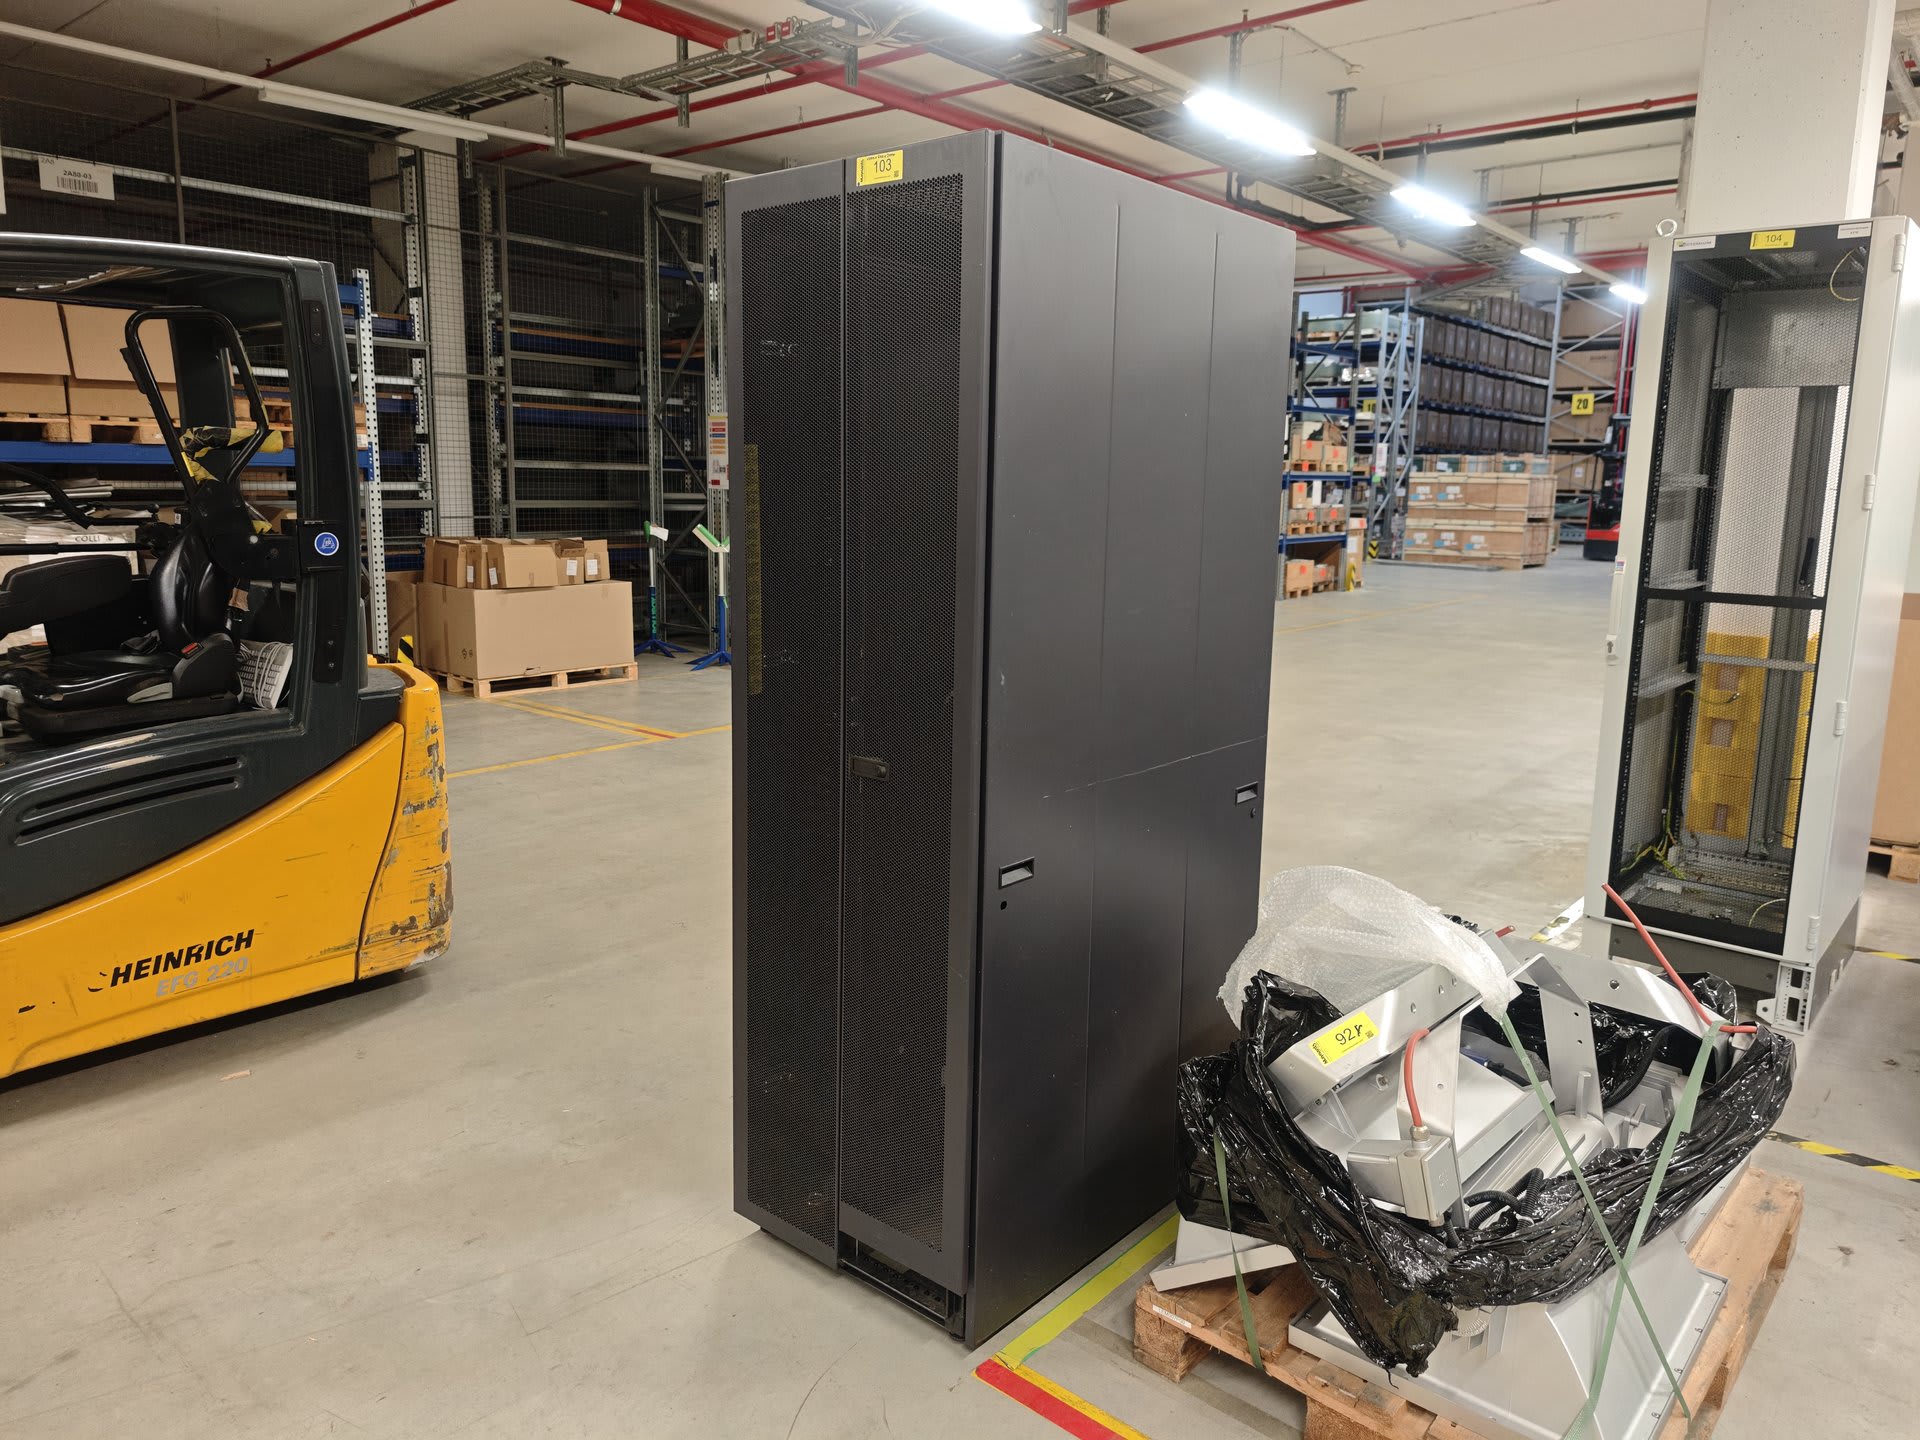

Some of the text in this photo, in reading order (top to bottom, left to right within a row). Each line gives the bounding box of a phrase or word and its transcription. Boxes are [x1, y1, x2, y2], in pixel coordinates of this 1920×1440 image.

[873, 158, 892, 173] 103
[1766, 234, 1782, 243] 104
[1576, 398, 1589, 410] 20
[88, 929, 255, 992] HEINRICH
[155, 956, 249, 998] EFG 220
